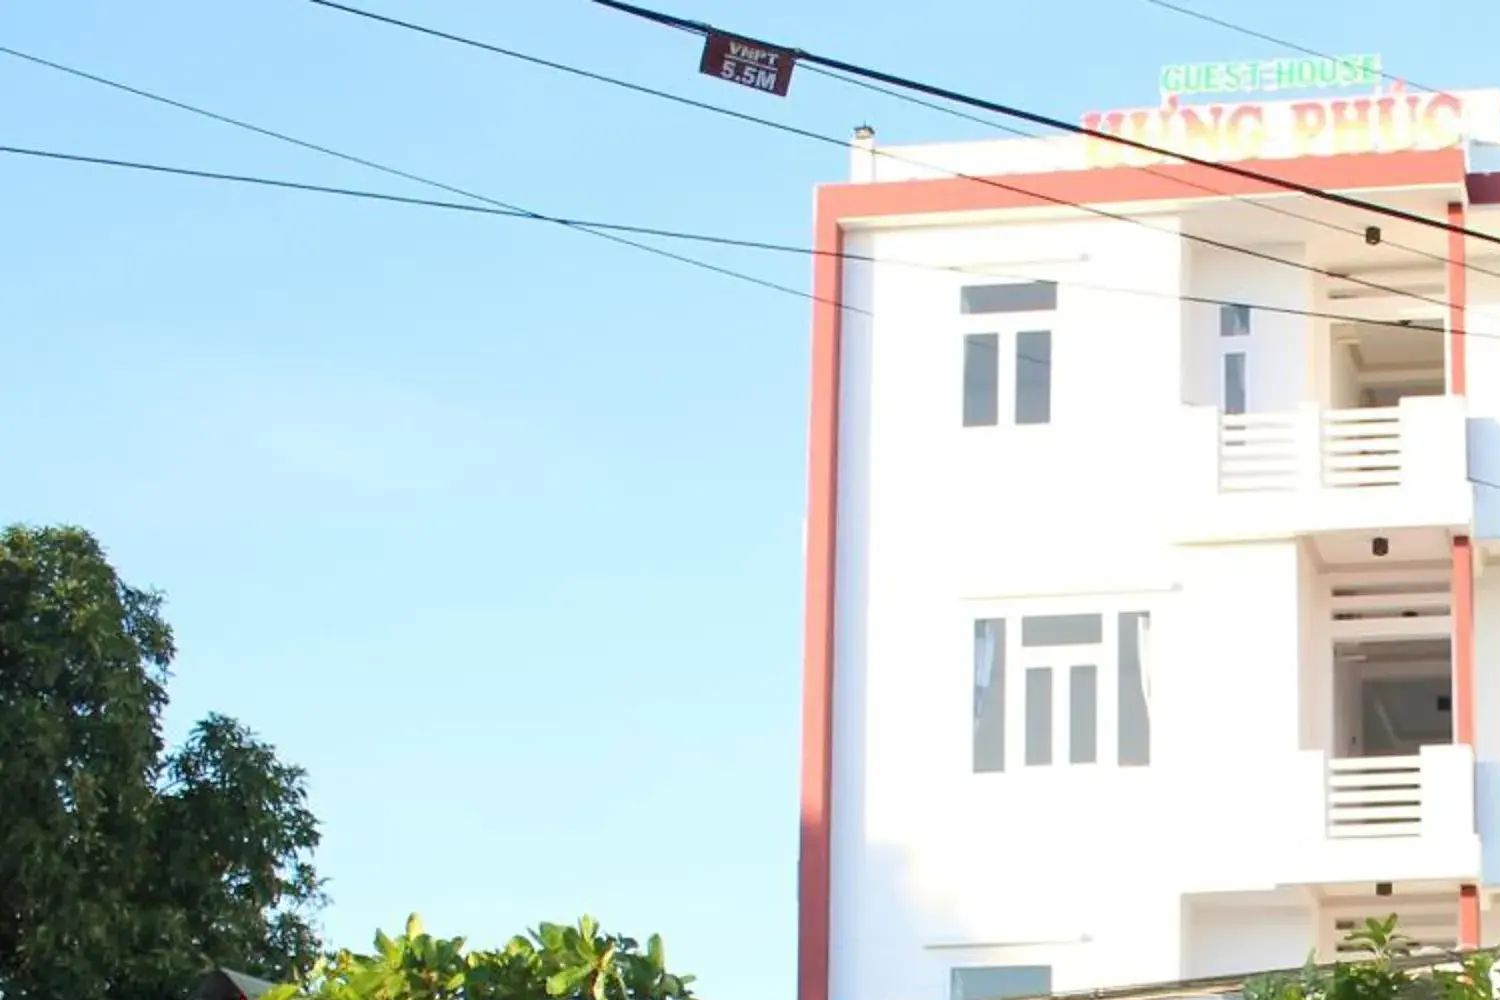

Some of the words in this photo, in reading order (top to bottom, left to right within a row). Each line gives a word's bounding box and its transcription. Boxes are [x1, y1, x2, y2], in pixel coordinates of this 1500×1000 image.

[721, 60, 777, 91] 5.5M
[1163, 61, 1260, 92] GUEST
[1276, 54, 1374, 86] HOUSE
